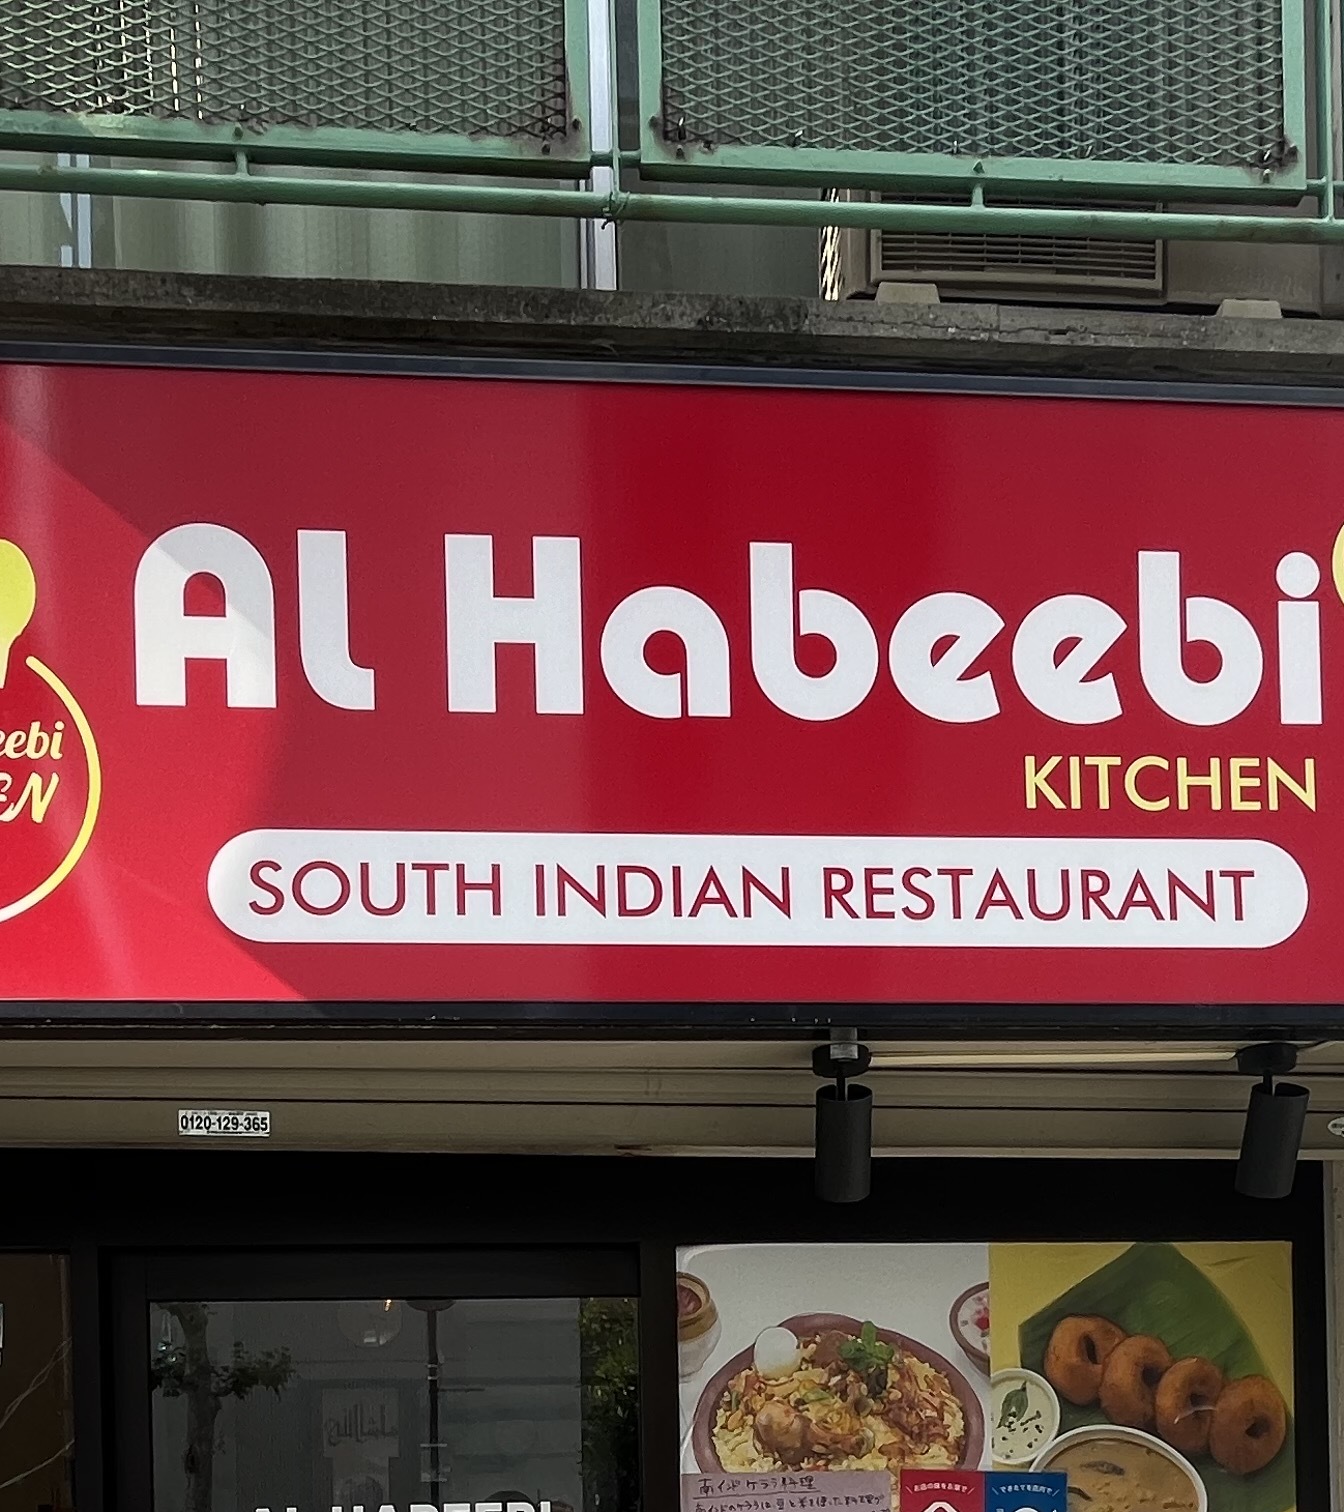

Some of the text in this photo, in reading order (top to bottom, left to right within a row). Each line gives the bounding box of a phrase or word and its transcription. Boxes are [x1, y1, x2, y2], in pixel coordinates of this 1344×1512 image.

[444, 533, 1324, 727] Habeebi
[1024, 755, 1317, 813] KITCHEN
[248, 860, 1256, 922] SOUTH INDIAN RESTAURANT
[180, 1114, 268, 1132] 0120-129-365
